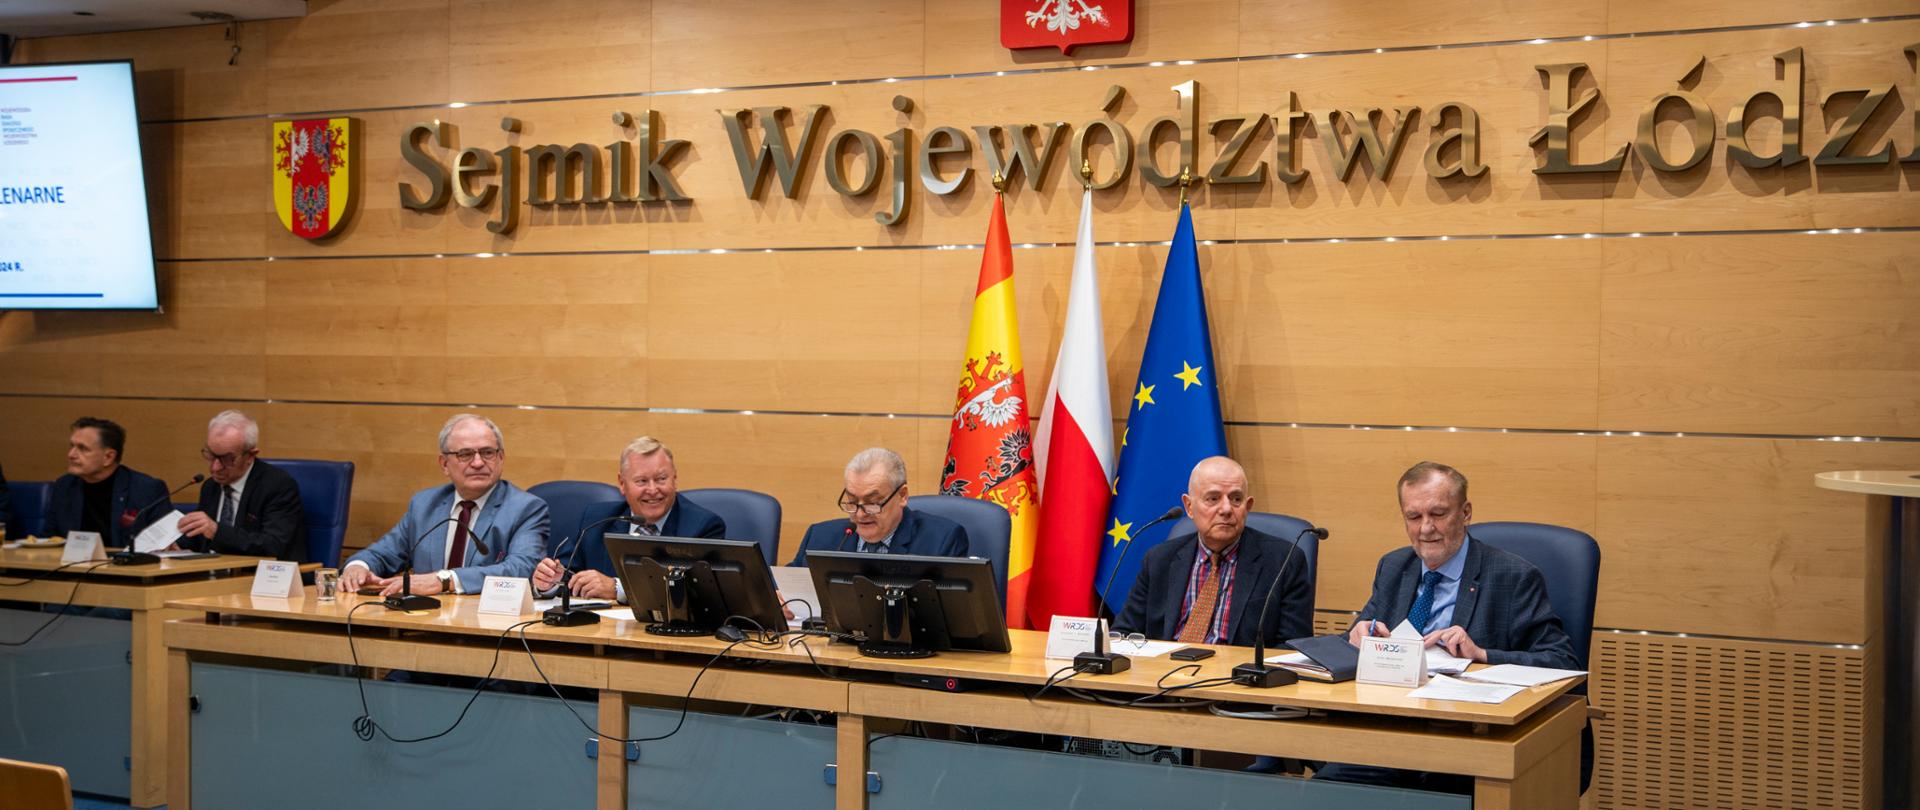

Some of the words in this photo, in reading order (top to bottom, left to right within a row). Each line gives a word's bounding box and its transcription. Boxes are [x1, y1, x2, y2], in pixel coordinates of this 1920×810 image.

[398, 109, 694, 235] Sejmik
[716, 79, 1491, 227] Województwa
[1374, 643, 1400, 653] WRDS
